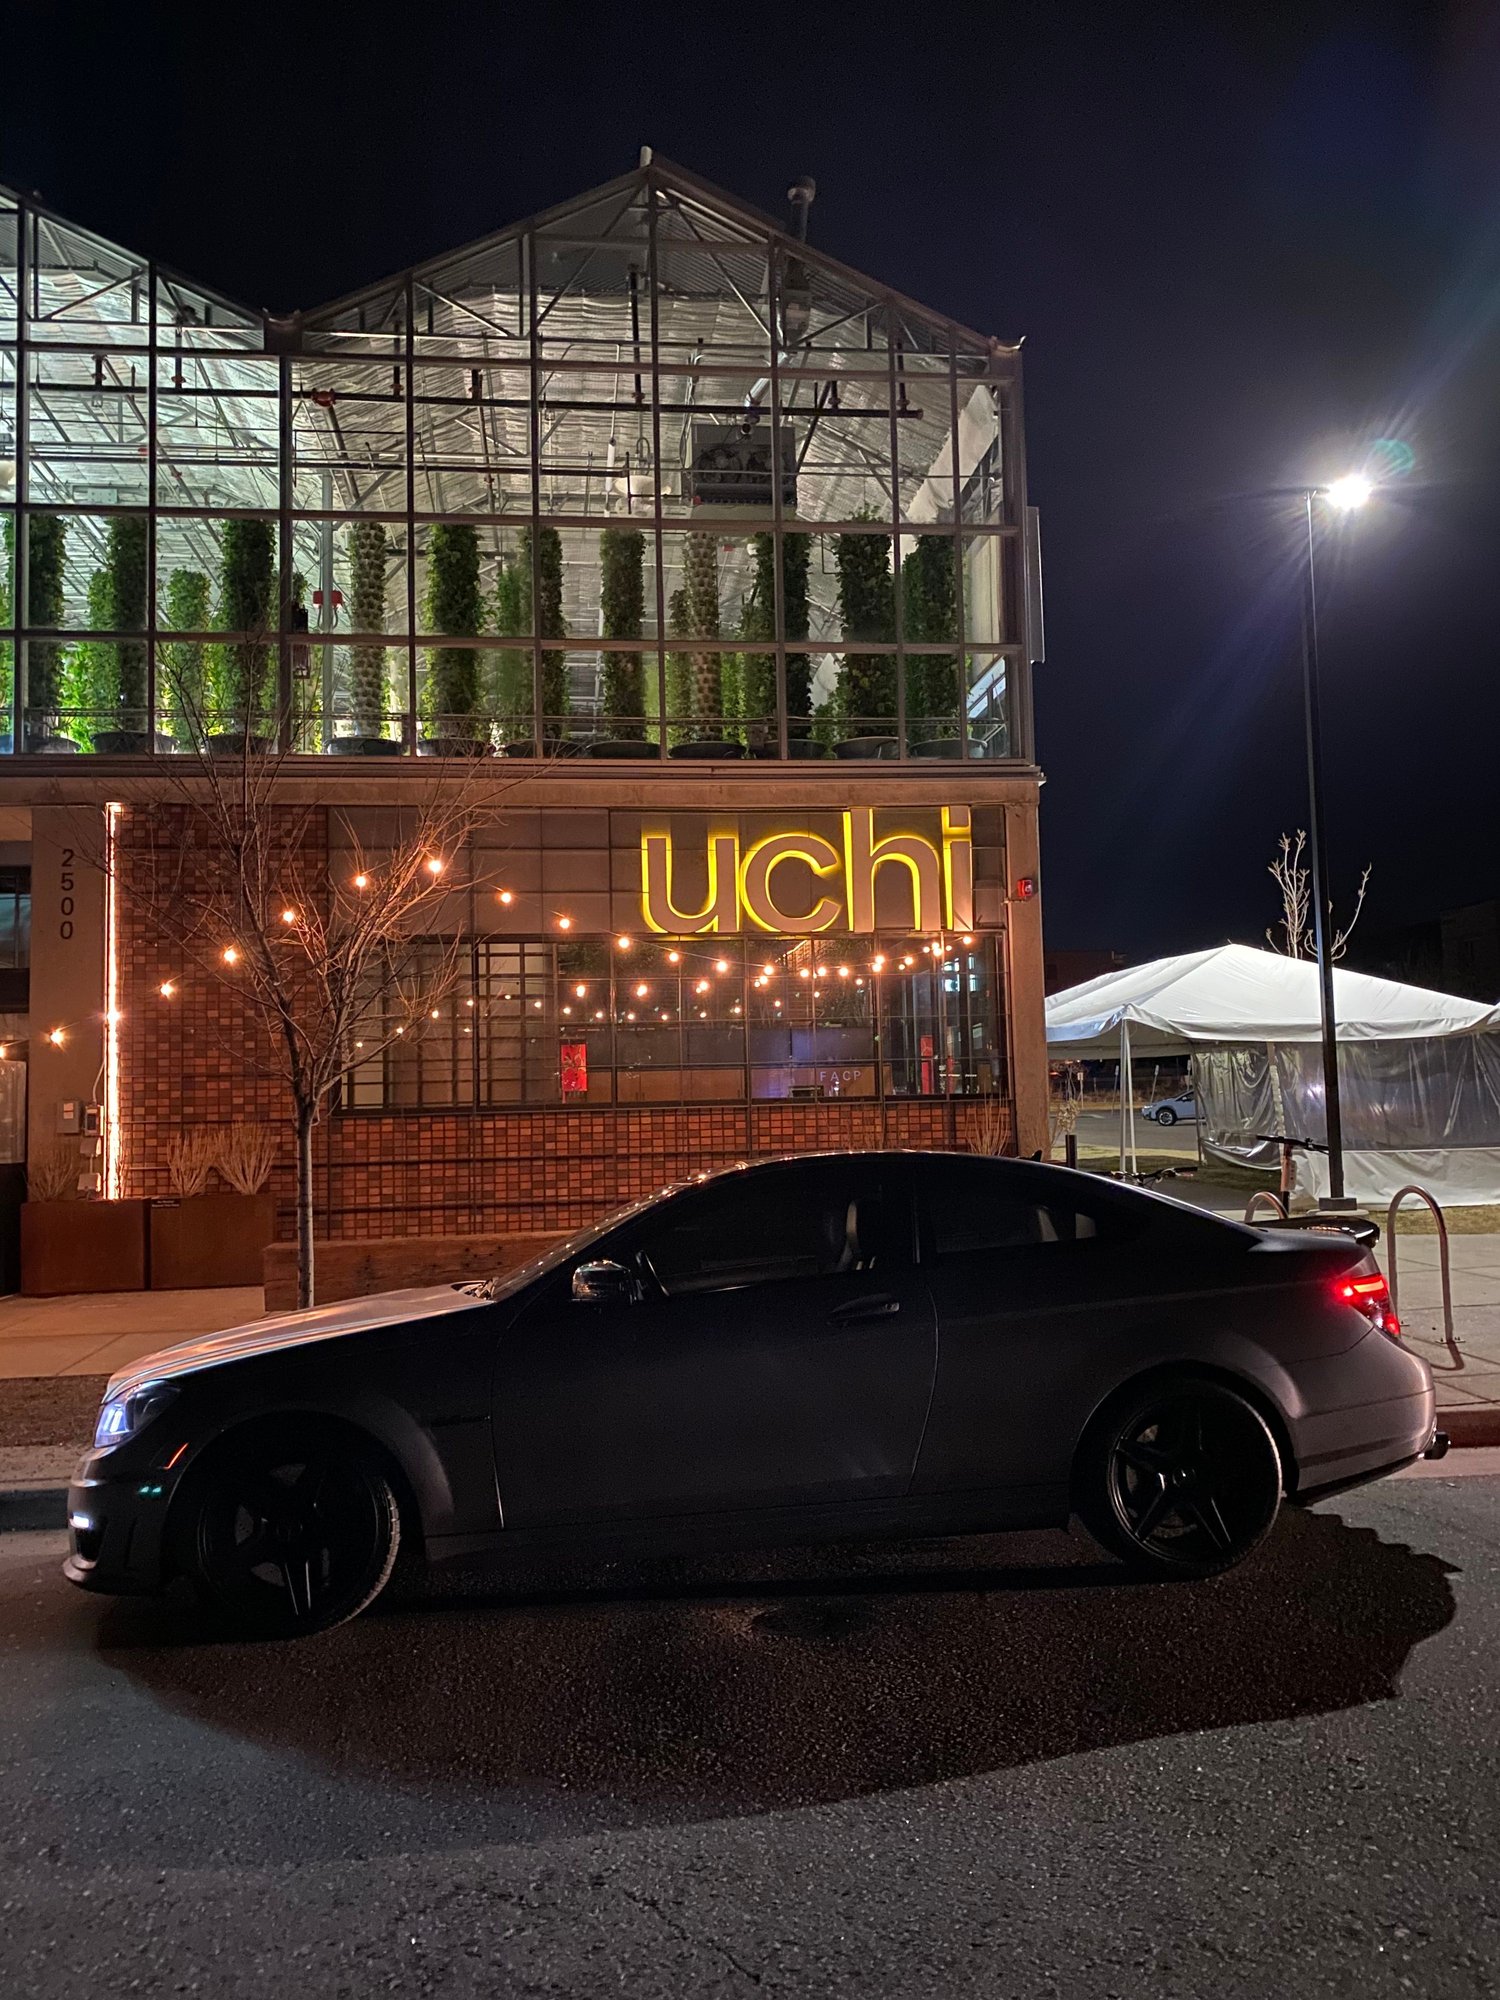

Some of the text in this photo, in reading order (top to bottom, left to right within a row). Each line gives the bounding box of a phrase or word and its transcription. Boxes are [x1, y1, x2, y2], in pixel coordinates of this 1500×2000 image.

[60, 848, 74, 940] 2500
[642, 806, 973, 933] uchi
[819, 1070, 861, 1082] FACP
